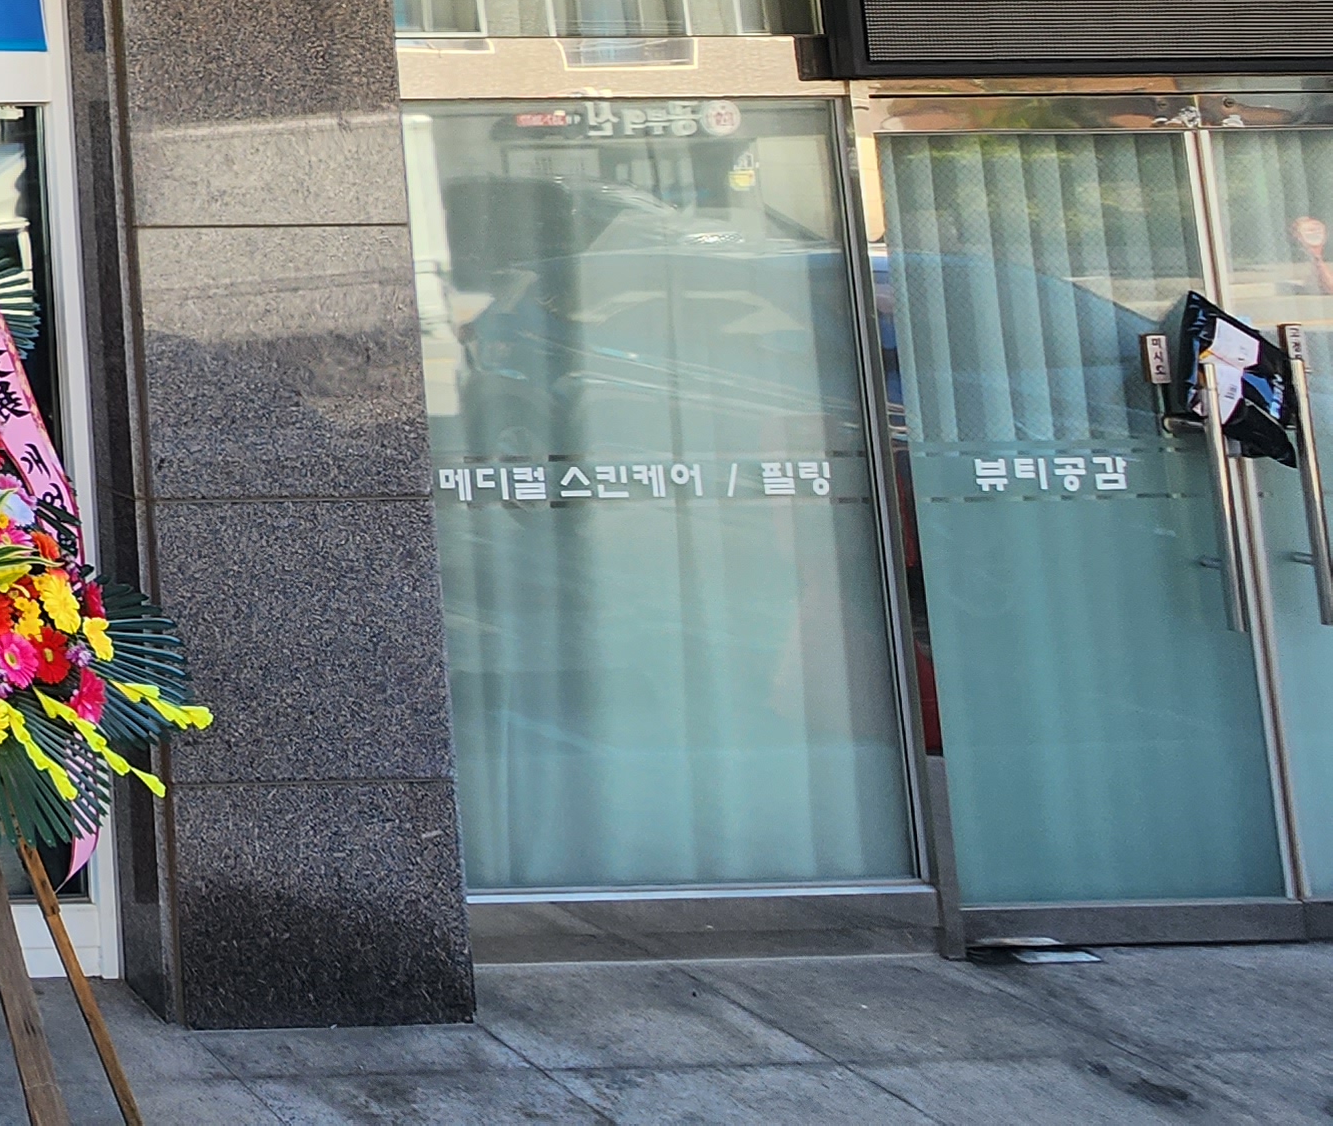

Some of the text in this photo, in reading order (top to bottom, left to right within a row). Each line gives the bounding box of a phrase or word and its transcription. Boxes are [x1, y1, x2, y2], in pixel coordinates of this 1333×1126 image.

[1151, 338, 1167, 377] 미시오
[439, 466, 547, 501] 메디컬
[560, 463, 703, 498] 스킨케어
[761, 461, 831, 495] 필링
[973, 456, 1128, 493] 뷰티공감
